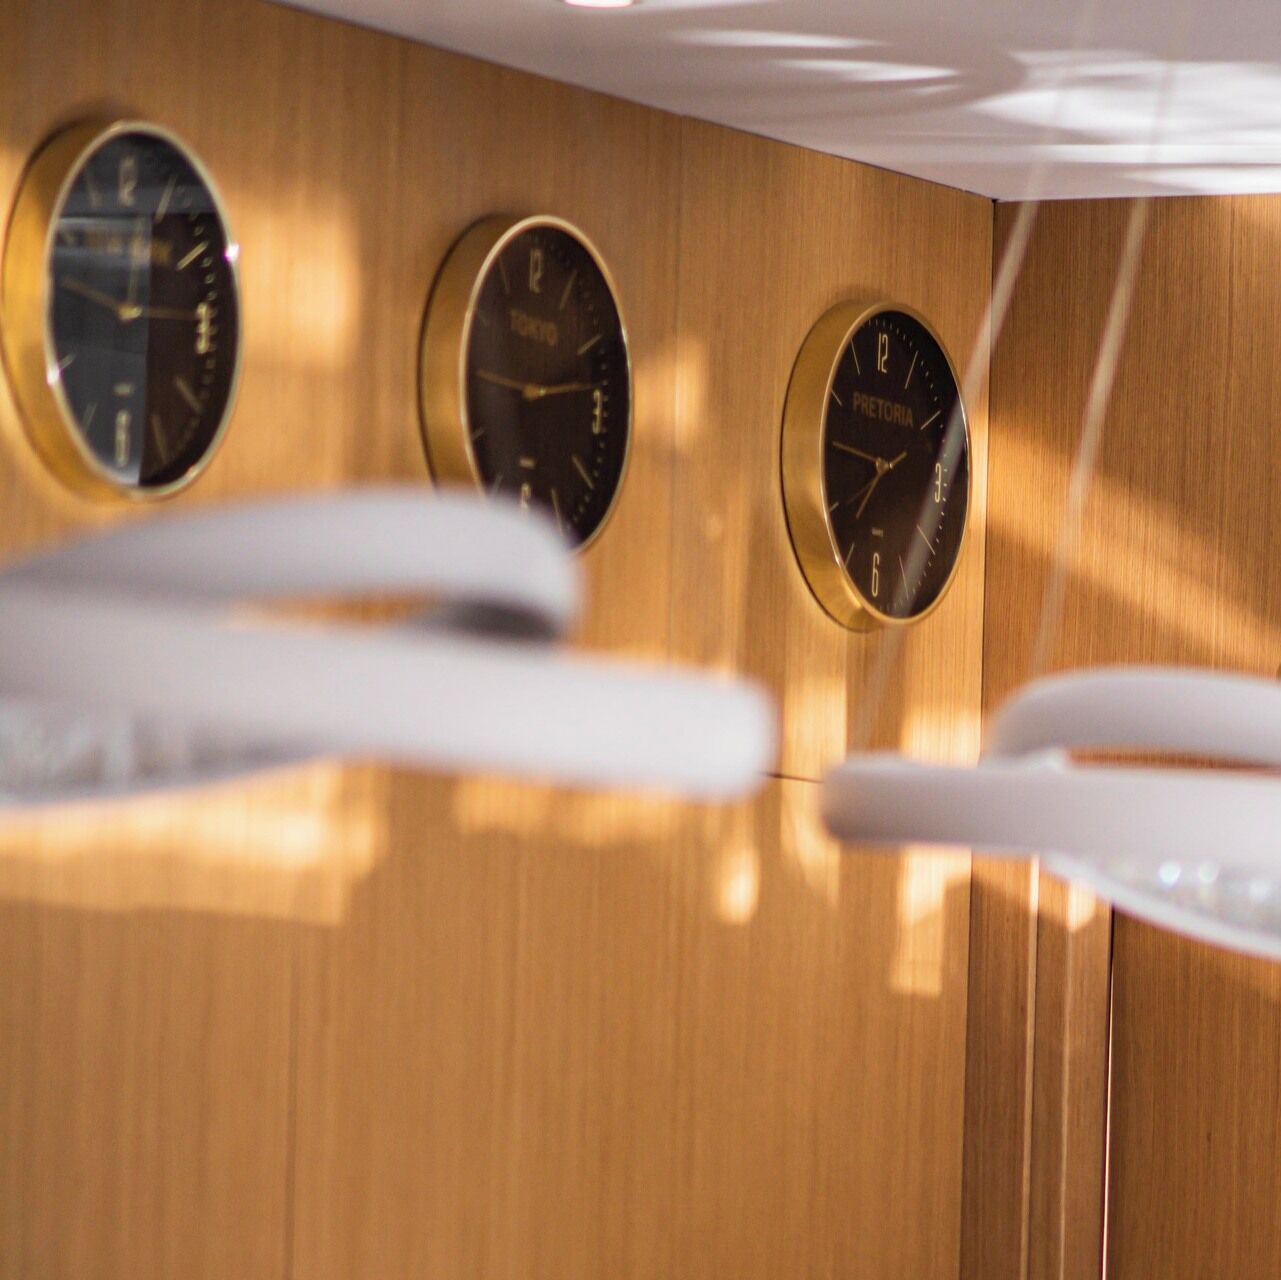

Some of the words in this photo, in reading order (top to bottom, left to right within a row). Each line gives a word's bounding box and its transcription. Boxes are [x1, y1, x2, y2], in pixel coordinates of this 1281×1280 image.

[530, 249, 544, 294] 12
[510, 309, 560, 347] TOKYO
[877, 332, 889, 374] 12
[592, 387, 601, 434] 3
[853, 391, 914, 427] PRETORIA
[934, 463, 942, 503] 3
[871, 552, 880, 597] 6
